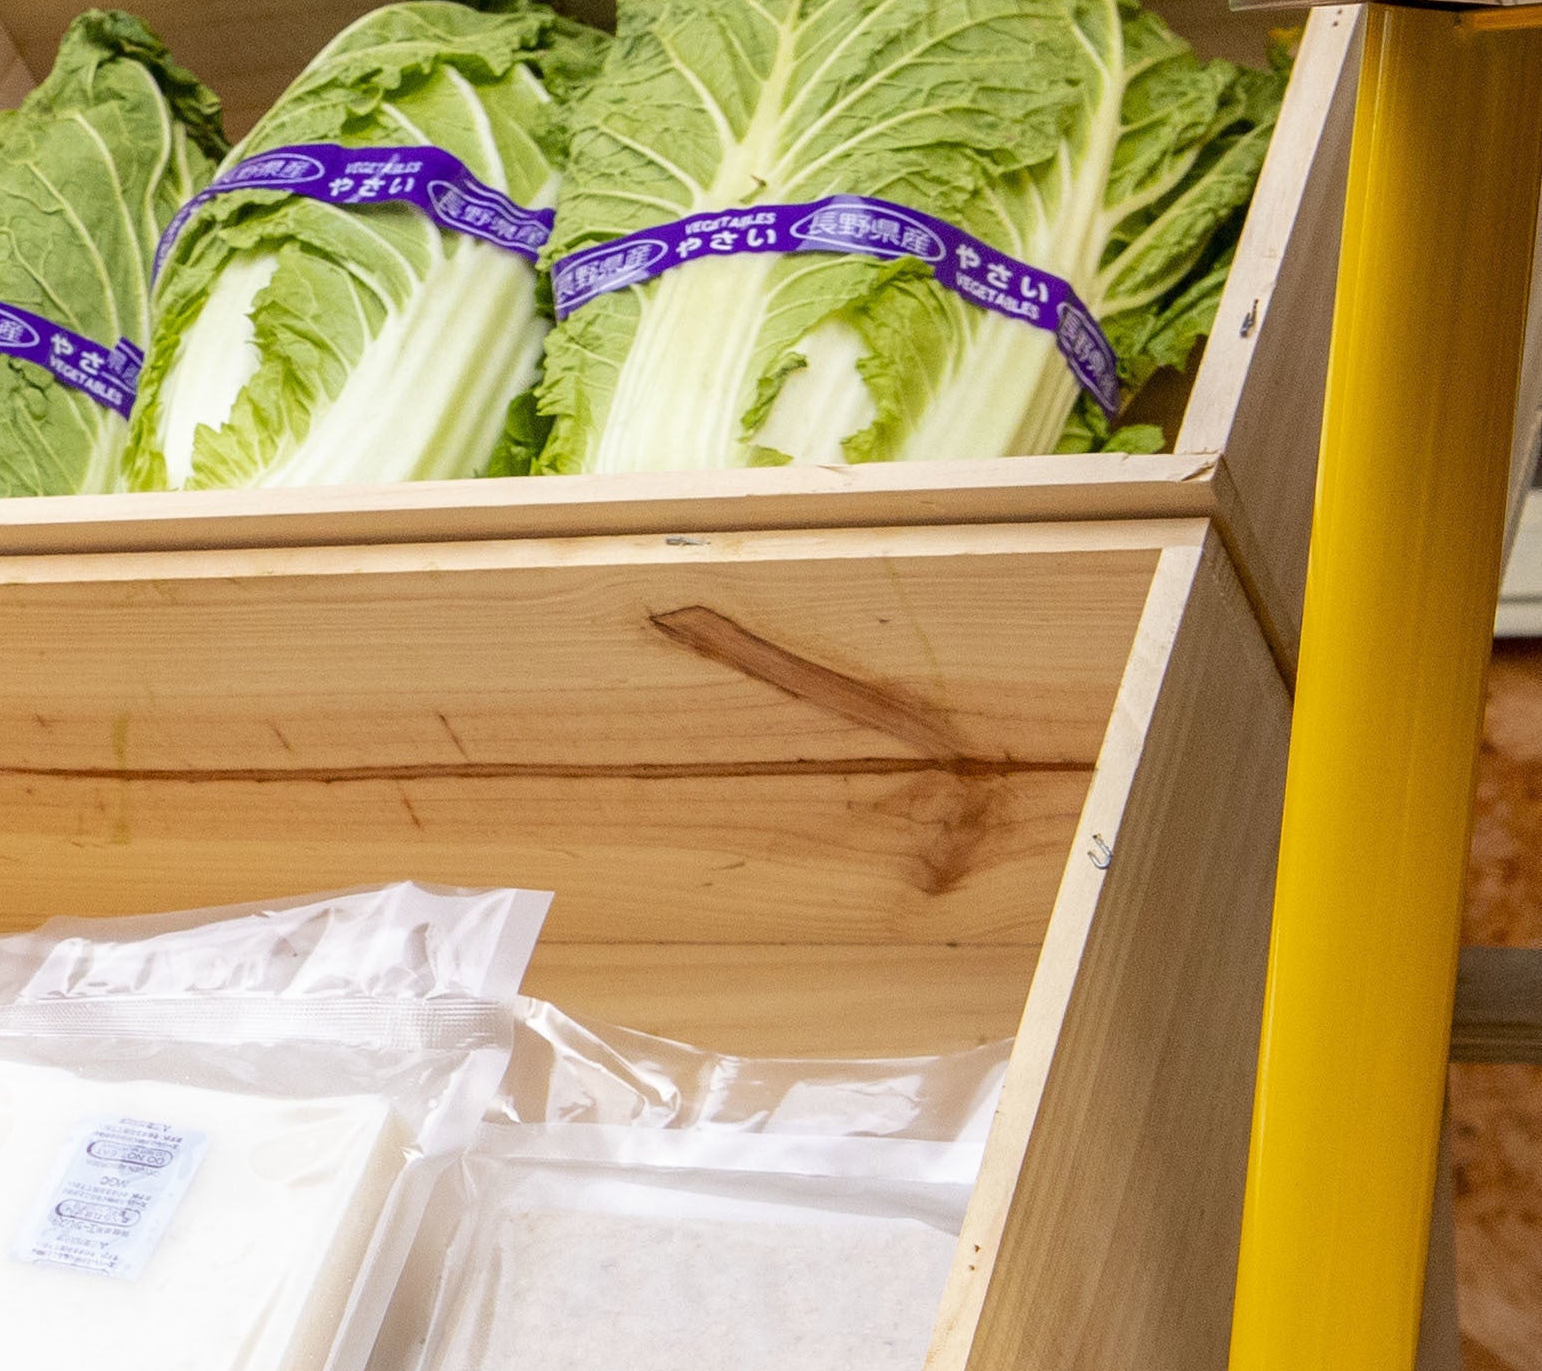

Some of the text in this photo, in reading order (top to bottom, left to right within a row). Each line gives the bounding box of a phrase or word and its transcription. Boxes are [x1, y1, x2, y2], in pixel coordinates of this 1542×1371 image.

[328, 177, 414, 197] やさい
[685, 212, 776, 235] VEGETABLES
[676, 228, 776, 259] やさい
[808, 212, 931, 256] 長野県産
[955, 243, 1049, 303] やさい
[955, 272, 1041, 320] VEGETABLES
[49, 355, 123, 405] VEGETABLES
